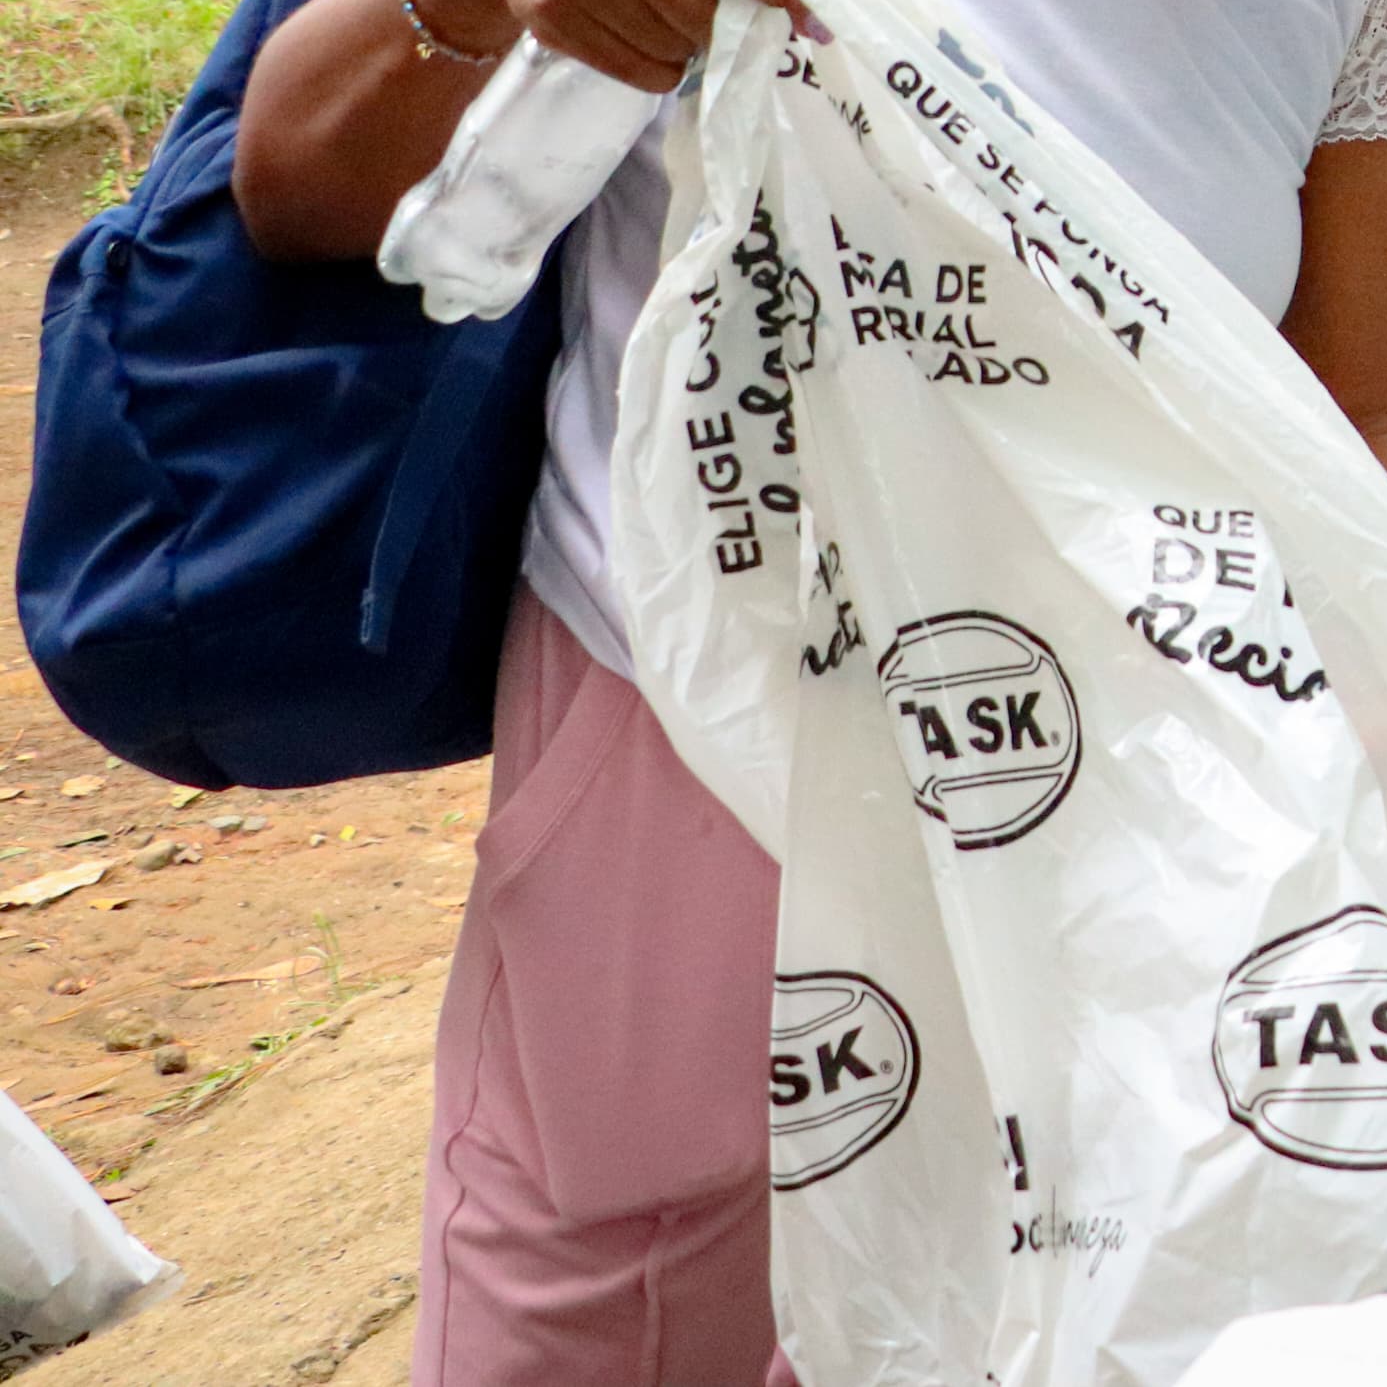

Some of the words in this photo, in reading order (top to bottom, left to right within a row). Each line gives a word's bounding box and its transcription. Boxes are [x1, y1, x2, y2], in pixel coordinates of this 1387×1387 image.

[886, 60, 976, 146] QUE
[976, 142, 1025, 196] SE
[935, 264, 988, 305] DE
[924, 350, 1050, 386] ADO
[686, 411, 764, 575] ELIGE
[1152, 503, 1255, 539] QUE
[1152, 537, 1257, 592] DE
